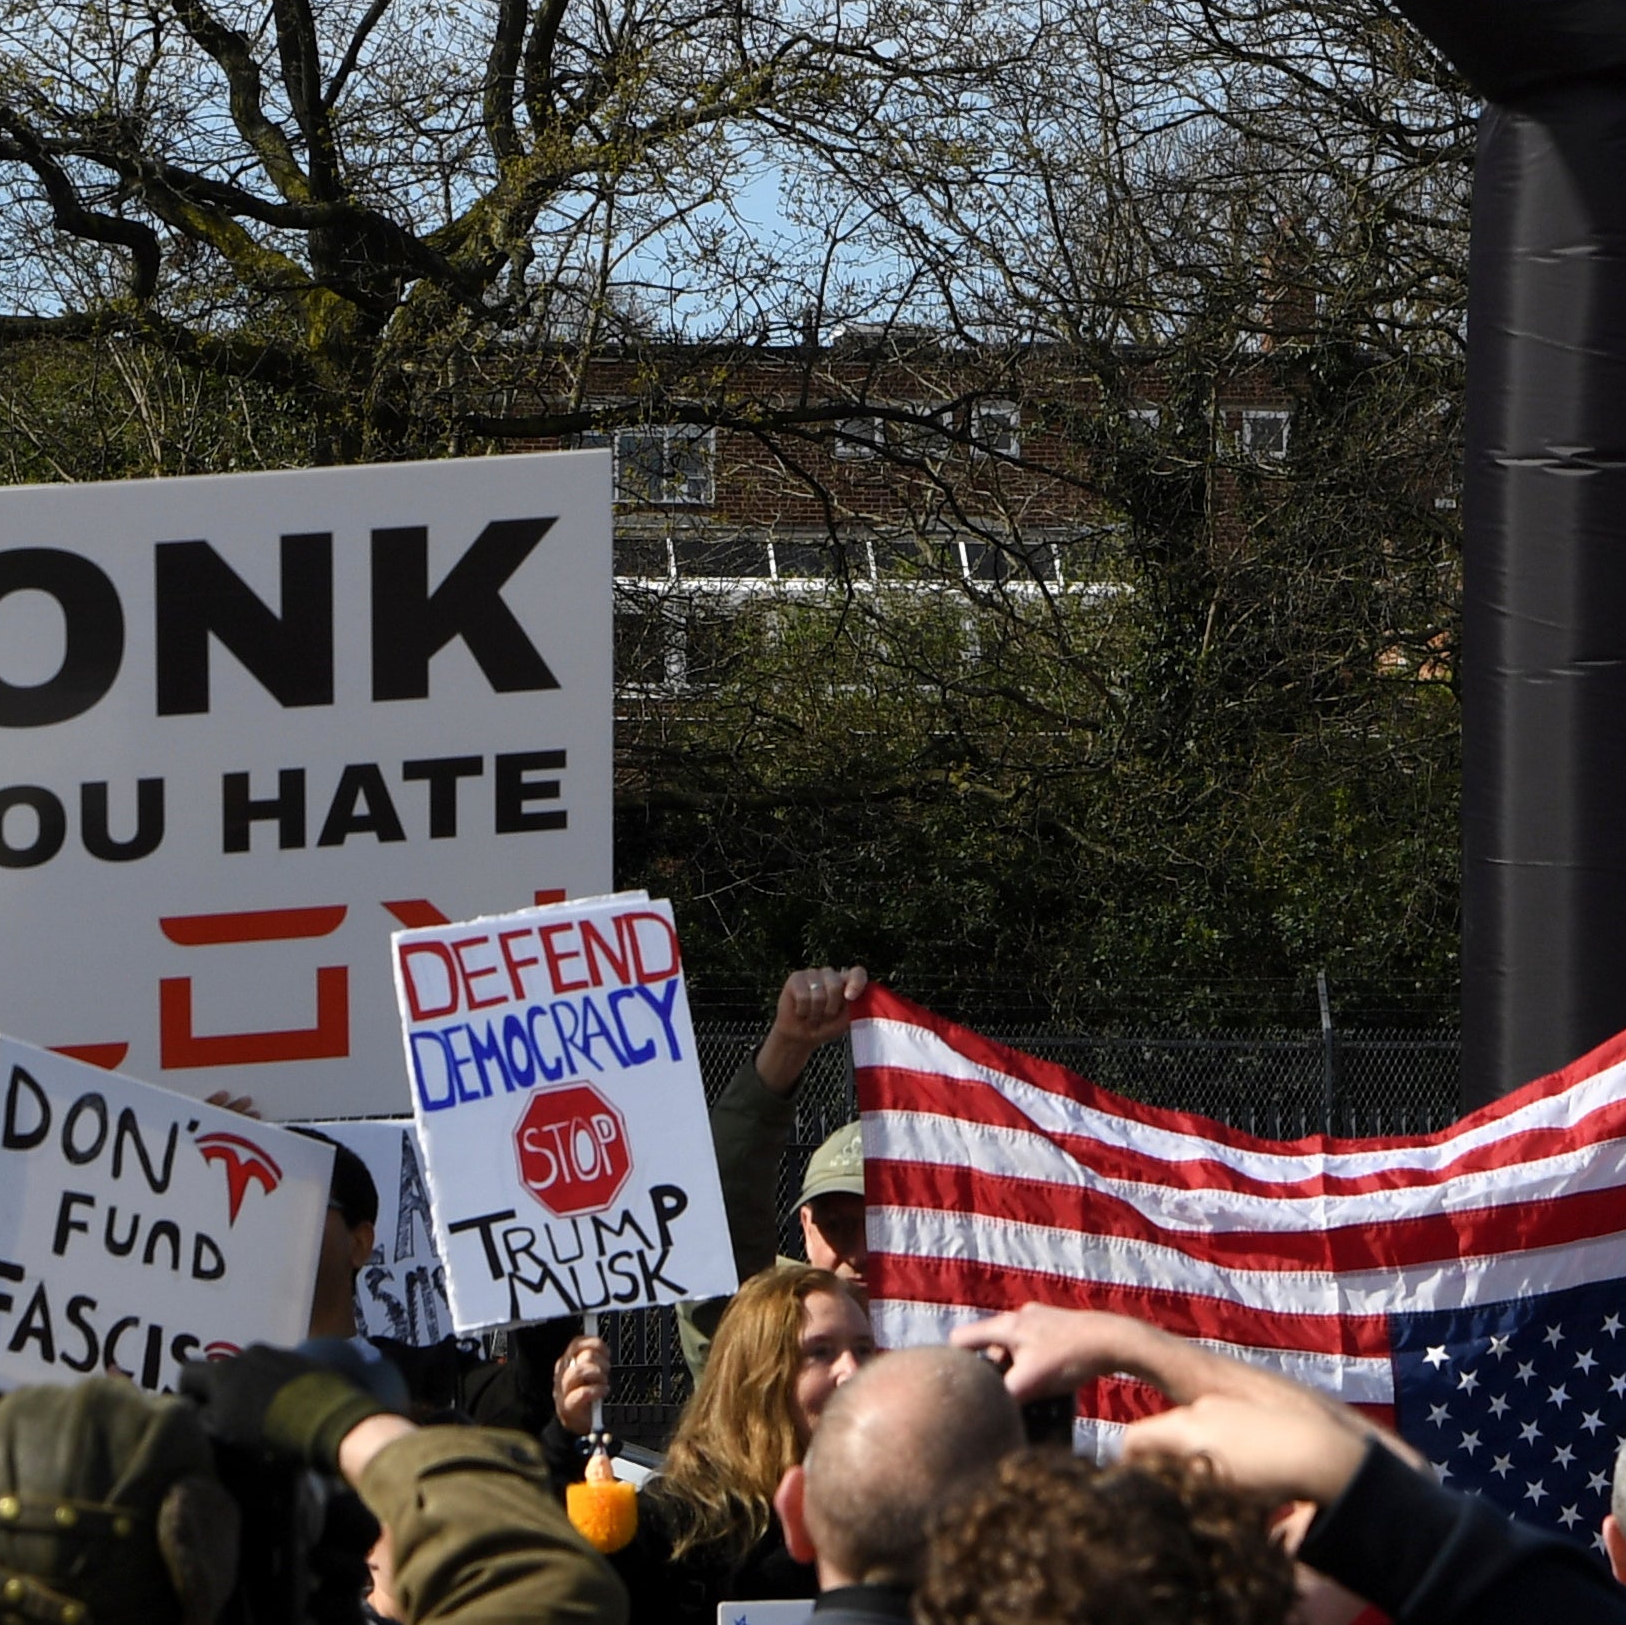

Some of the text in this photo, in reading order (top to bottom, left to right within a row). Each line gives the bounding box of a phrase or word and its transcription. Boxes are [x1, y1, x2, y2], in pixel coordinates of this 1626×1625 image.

[221, 749, 569, 855] HATE
[398, 911, 681, 1022] DEFEND
[410, 979, 683, 1112] DEMOCRACY
[522, 1113, 617, 1190] STOP
[449, 1184, 688, 1281] TRUMP
[507, 1247, 689, 1320] MUSK
